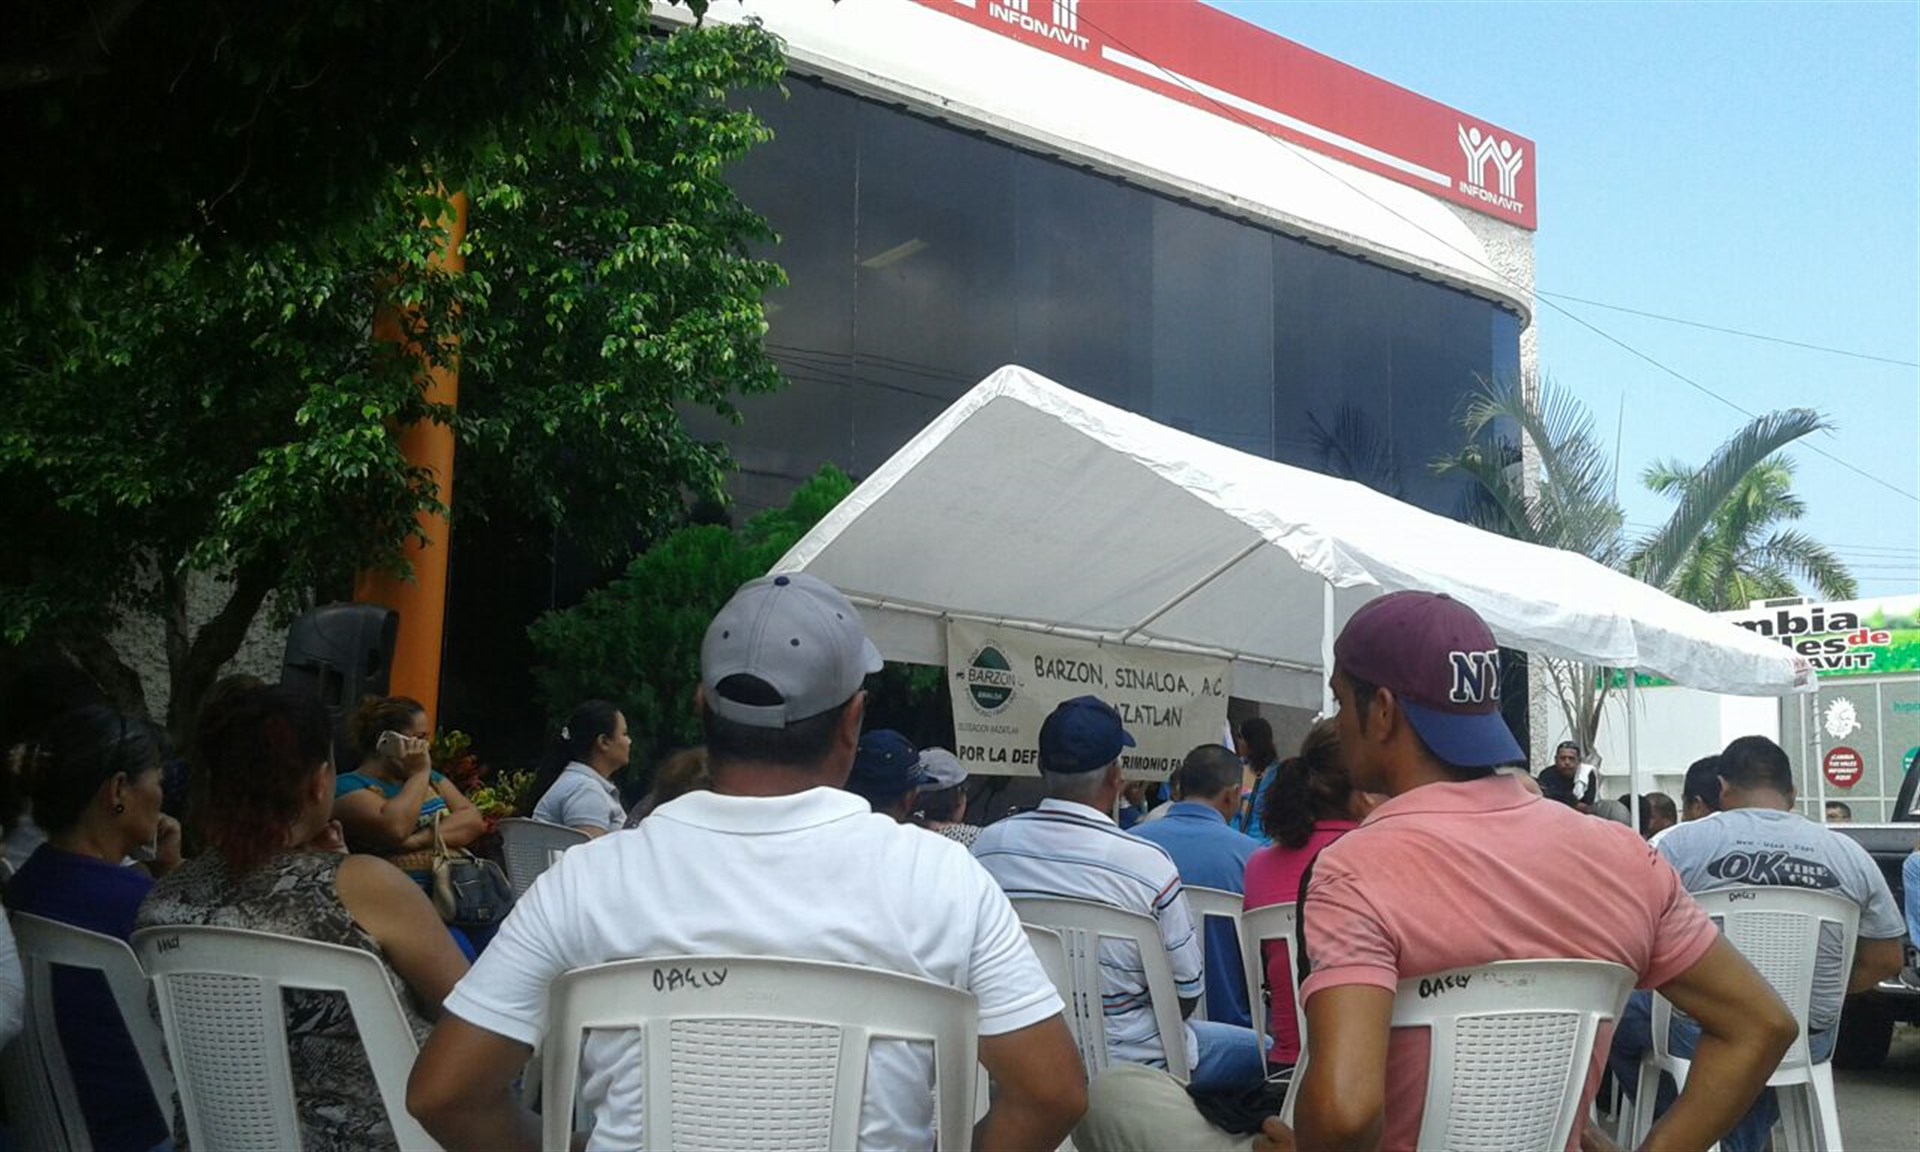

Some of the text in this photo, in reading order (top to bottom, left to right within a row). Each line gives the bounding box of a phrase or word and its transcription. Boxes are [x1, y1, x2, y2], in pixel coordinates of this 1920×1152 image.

[989, 1, 1090, 51] INFONAVIT
[1459, 180, 1524, 214] INFONAVIT
[968, 667, 1015, 686] BARZON
[1034, 654, 1108, 689] BARZON,
[1115, 668, 1194, 696] SINALOA,
[959, 745, 985, 762] POR
[989, 747, 1007, 763] LA
[1719, 851, 1828, 885] OK TIRE
[1788, 873, 1822, 888] CO.
